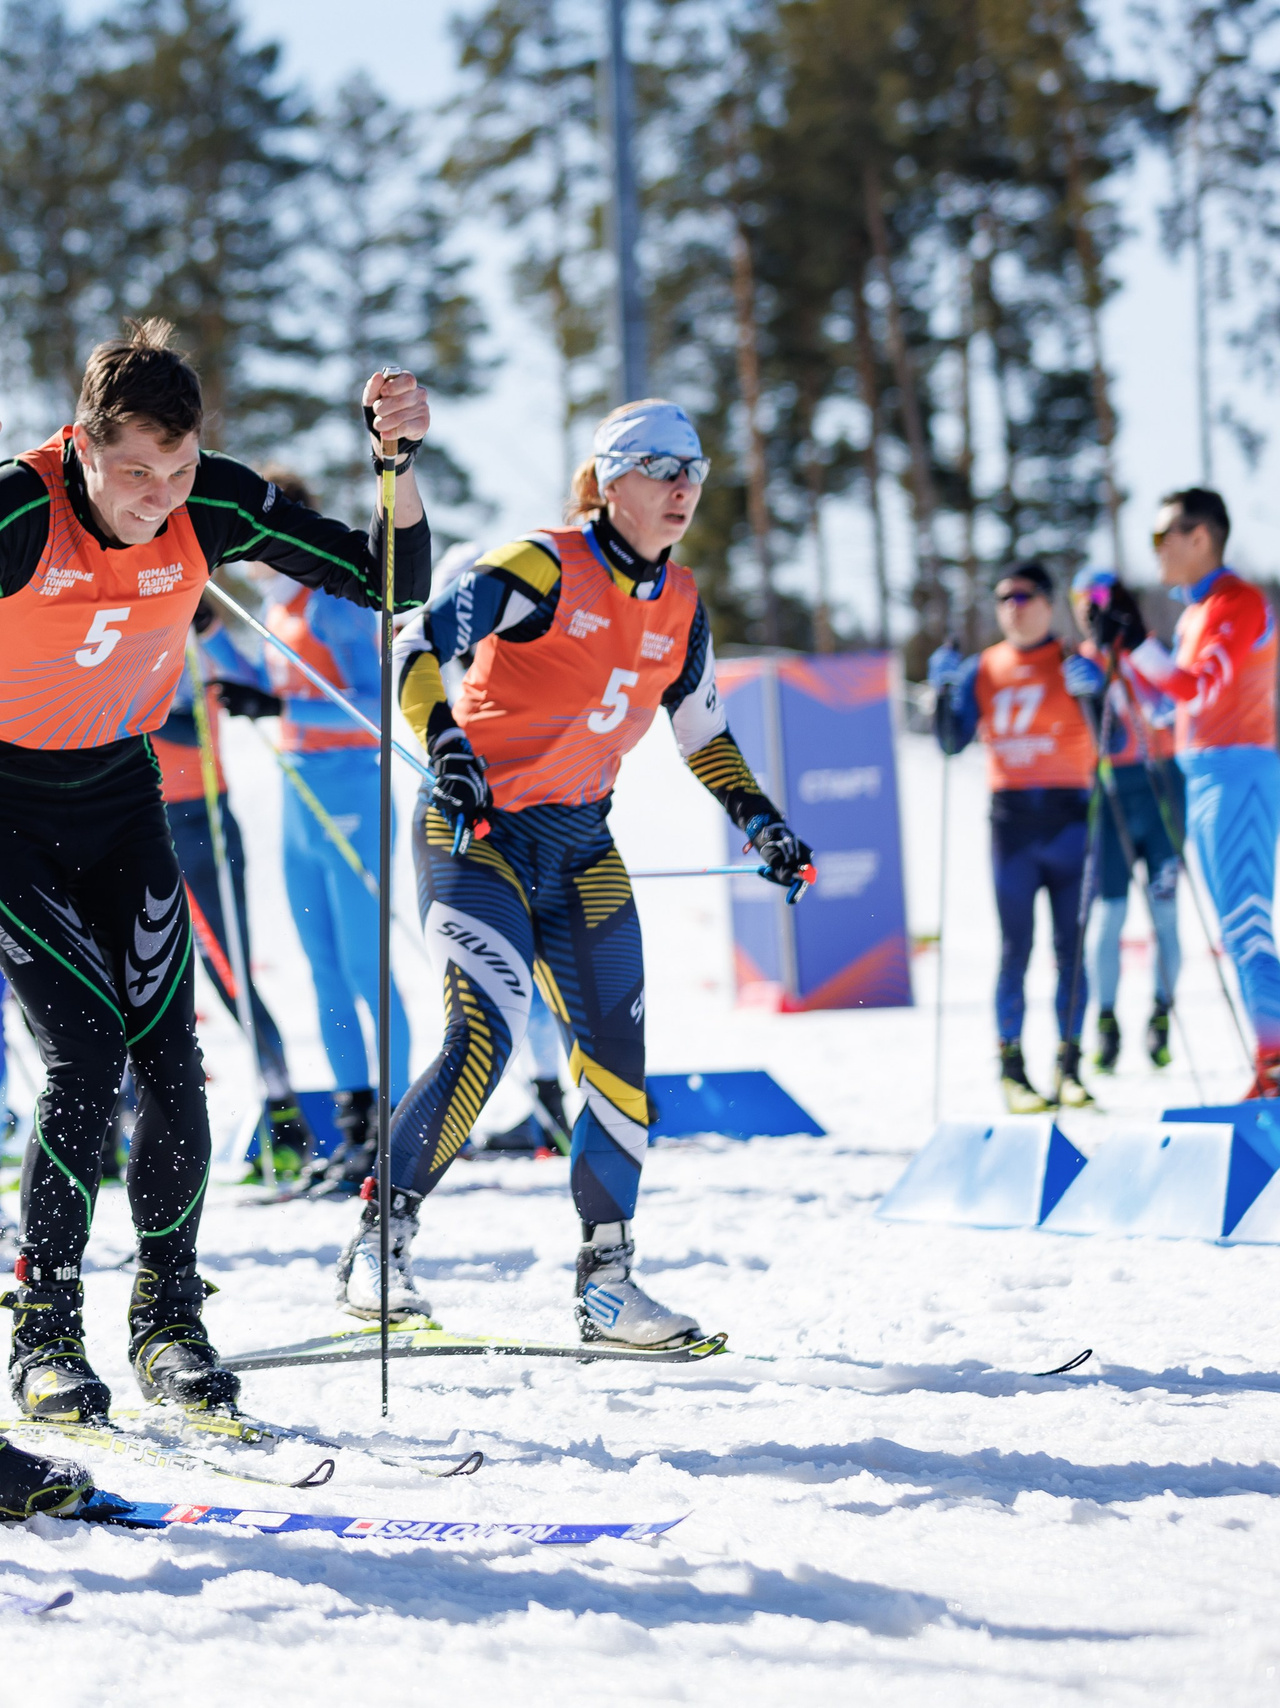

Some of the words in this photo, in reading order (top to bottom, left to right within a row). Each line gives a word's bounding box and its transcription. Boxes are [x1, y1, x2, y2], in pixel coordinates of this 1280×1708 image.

[74, 607, 131, 668] 5
[587, 667, 639, 734] 5
[992, 684, 1046, 735] 17
[437, 920, 527, 998] SILVINI
[13, 1302, 53, 1310] FCHER
